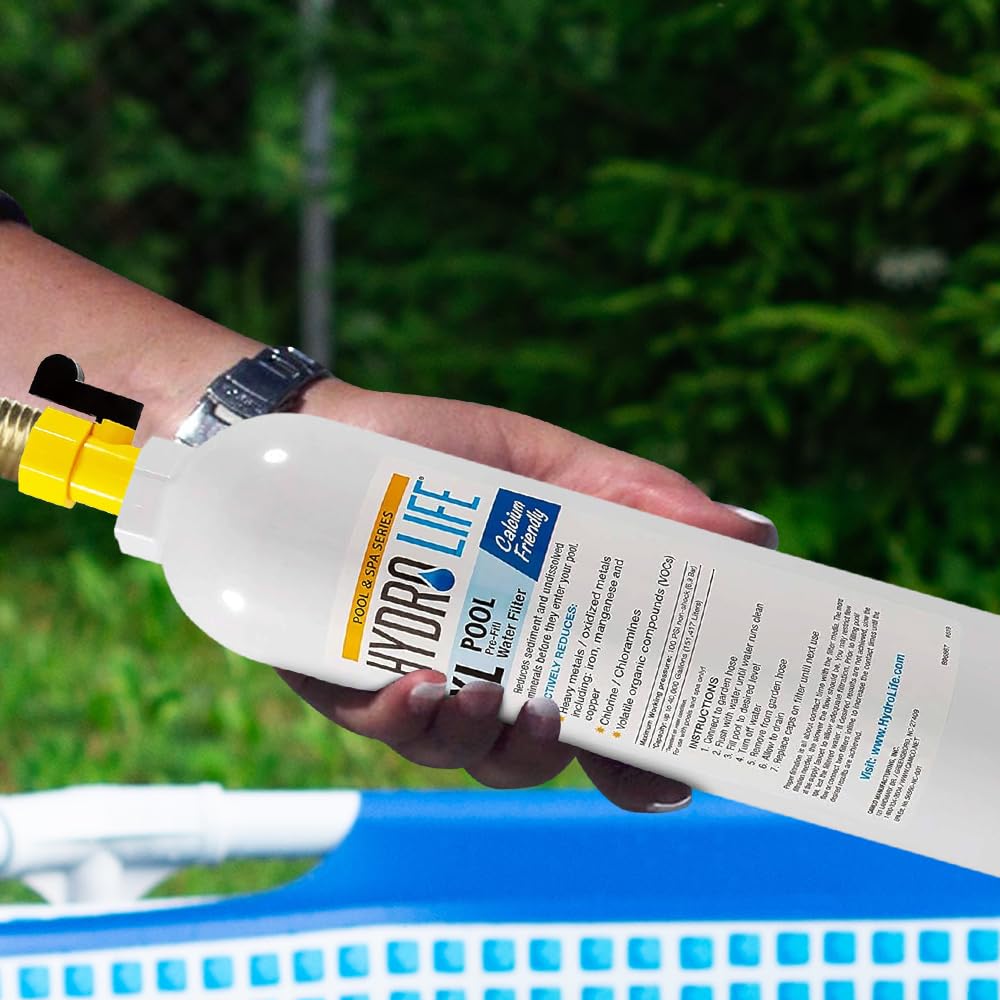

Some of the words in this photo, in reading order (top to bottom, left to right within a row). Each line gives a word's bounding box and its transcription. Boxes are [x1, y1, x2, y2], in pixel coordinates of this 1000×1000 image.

[372, 510, 394, 551] SERIES
[495, 500, 525, 553] Calcium
[514, 508, 548, 563] Friendly
[566, 543, 579, 564] pool.
[364, 554, 381, 577] SPA
[559, 563, 572, 585] your
[595, 556, 612, 590] metals
[361, 579, 373, 590] &
[552, 585, 566, 610] enter
[352, 594, 369, 625] POOL
[365, 557, 454, 678] HYDRO
[513, 659, 531, 694] Reduces
[524, 615, 543, 659] sediment
[536, 595, 549, 614] and
[543, 542, 565, 594] undissolved
[581, 591, 601, 639] oxidized
[752, 603, 764, 624] clean
[460, 598, 496, 652] POOL
[496, 623, 517, 658] Water
[507, 588, 527, 621] Filter
[543, 611, 560, 632] they
[671, 626, 681, 640] PSI
[484, 621, 502, 656] Pre-Fill
[571, 672, 593, 718] including:
[584, 647, 601, 670] iron,
[594, 580, 618, 643] manganese
[612, 558, 624, 579] and
[577, 639, 588, 648] /
[614, 609, 642, 678] Chloramines
[616, 697, 634, 730] Volatile
[629, 655, 647, 696] organic
[641, 588, 665, 653] compounds
[657, 555, 676, 587] (VOCs)
[748, 624, 759, 643] runs
[810, 630, 820, 646] use
[535, 634, 552, 664] before
[543, 660, 561, 701] CTIVELY
[554, 603, 578, 659] REDUCES:
[667, 640, 677, 653] 100
[741, 642, 754, 667] water
[805, 645, 817, 665] next
[447, 655, 505, 696] L
[569, 648, 585, 684] metals
[674, 653, 688, 680] Gallons
[724, 656, 738, 677] hose
[736, 667, 747, 686] until
[748, 662, 762, 684] level
[774, 658, 788, 680] hose
[800, 664, 812, 684] until
[527, 664, 543, 699] minerals
[611, 678, 621, 687] /
[667, 680, 680, 705] 40,000
[717, 677, 732, 706] garden
[558, 685, 576, 715] Heavy
[585, 687, 601, 722] copper
[648, 691, 664, 719] Working
[729, 686, 742, 710] water
[739, 683, 755, 714] desired
[768, 680, 782, 709] garden
[793, 683, 806, 704] filter
[599, 687, 619, 726] Chlorine
[663, 712, 671, 722] up
[665, 704, 673, 712] to
[689, 677, 719, 749] INSTRUCTIONS
[713, 706, 723, 715] to
[749, 703, 762, 726] water
[790, 704, 800, 716] on
[859, 757, 877, 780] Visit:
[871, 654, 905, 755] www.HydroLife.com
[703, 715, 720, 744] Connect
[723, 711, 734, 728] with
[735, 714, 746, 723] to
[759, 709, 774, 728] from
[772, 712, 785, 732] drain
[784, 716, 797, 736] caps
[714, 729, 728, 748] Flush
[732, 723, 743, 741] pool
[745, 725, 755, 738] off
[768, 732, 779, 741] to
[726, 739, 738, 751] Fill
[737, 738, 751, 754] Turn
[749, 729, 767, 758] Remove
[761, 741, 775, 762] Allow
[772, 736, 790, 764] Replace
